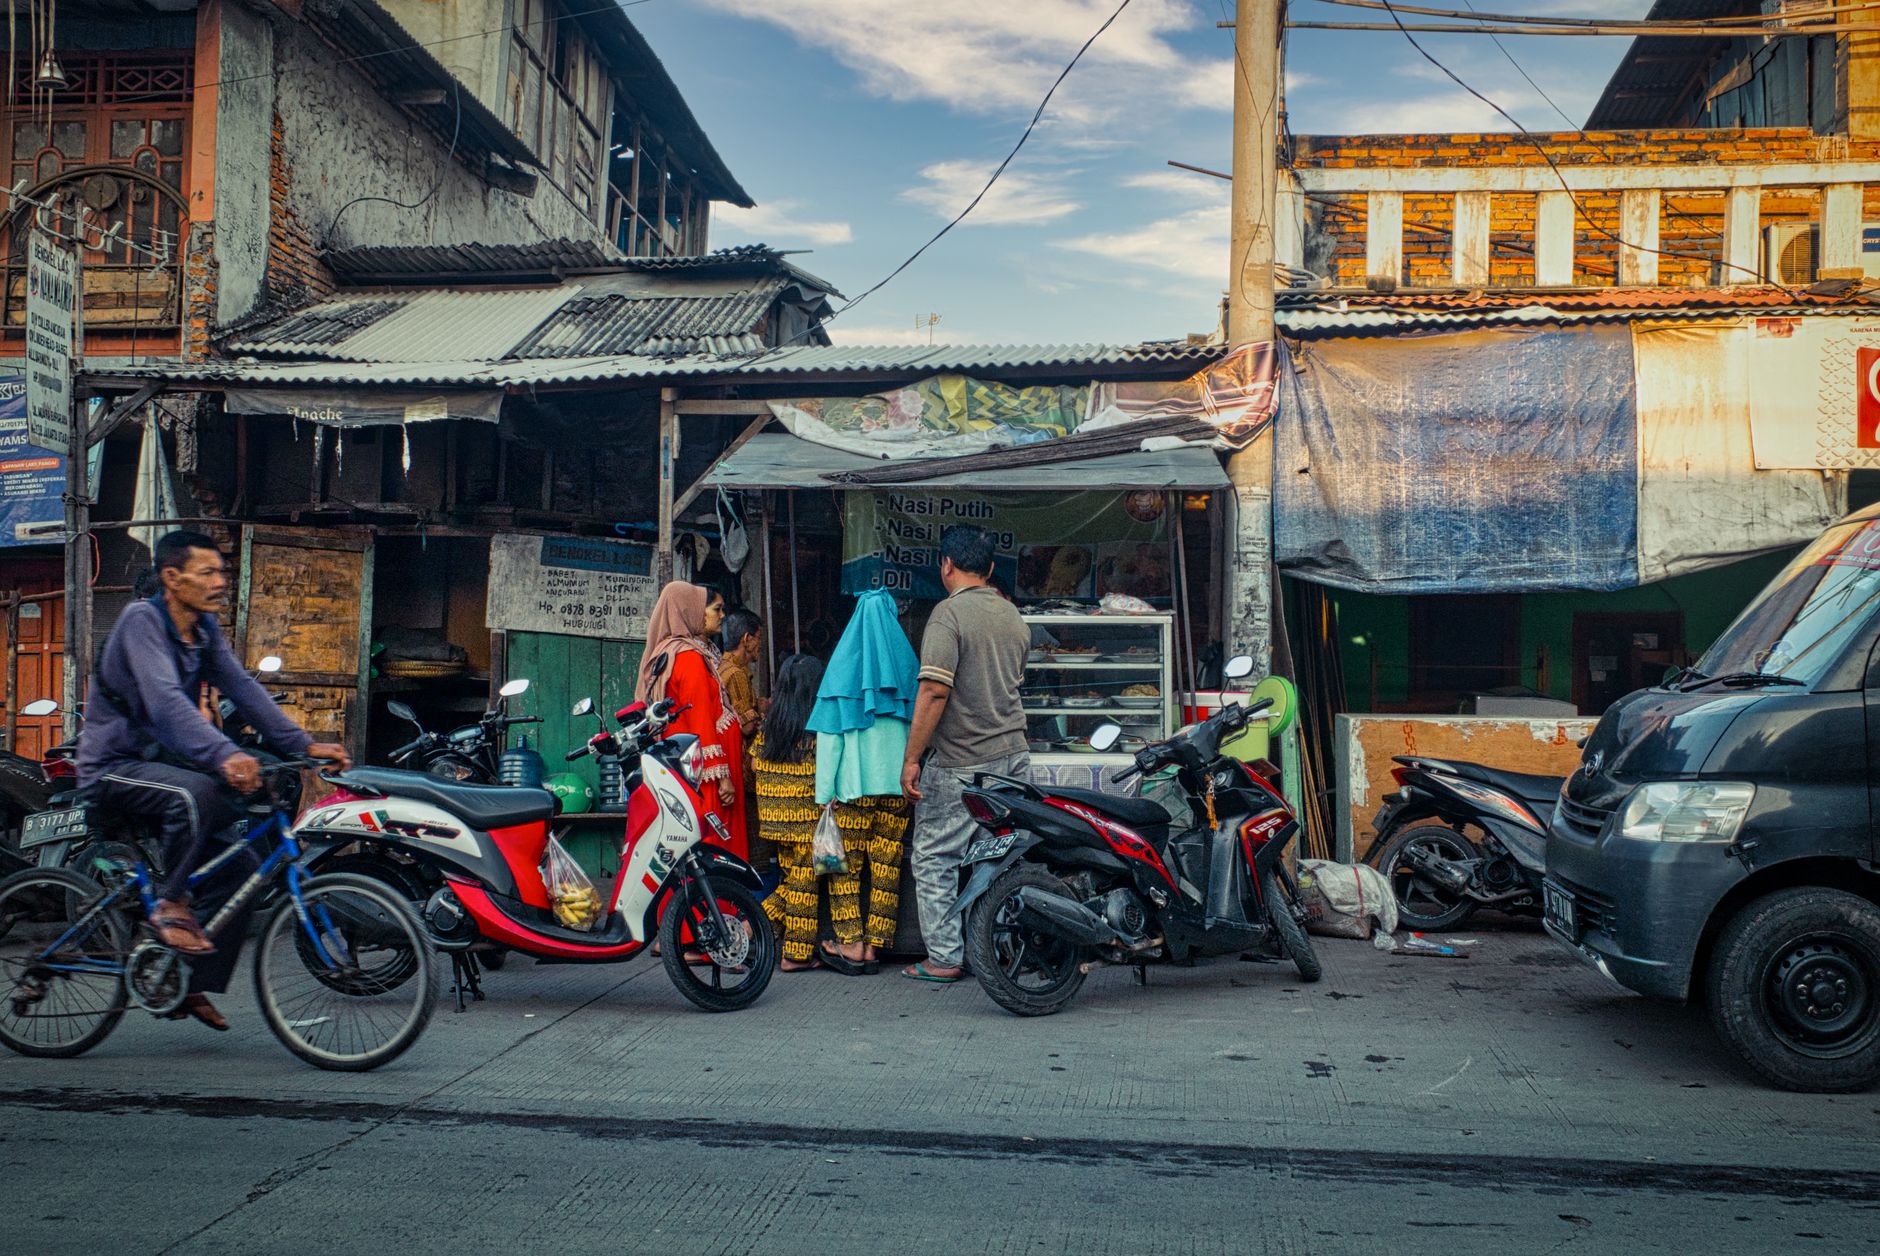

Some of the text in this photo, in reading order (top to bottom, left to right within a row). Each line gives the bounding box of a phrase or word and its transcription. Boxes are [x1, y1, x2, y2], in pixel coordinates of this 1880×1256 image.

[889, 494, 993, 518] Nasi Putih
[887, 518, 933, 541] Nasi
[885, 544, 931, 566] Nasi
[884, 570, 911, 589] Dll
[560, 603, 585, 616] 0878
[26, 820, 33, 831] B
[40, 813, 65, 828] 3177
[1249, 817, 1281, 834] 125
[666, 834, 688, 843] YAMAHA
